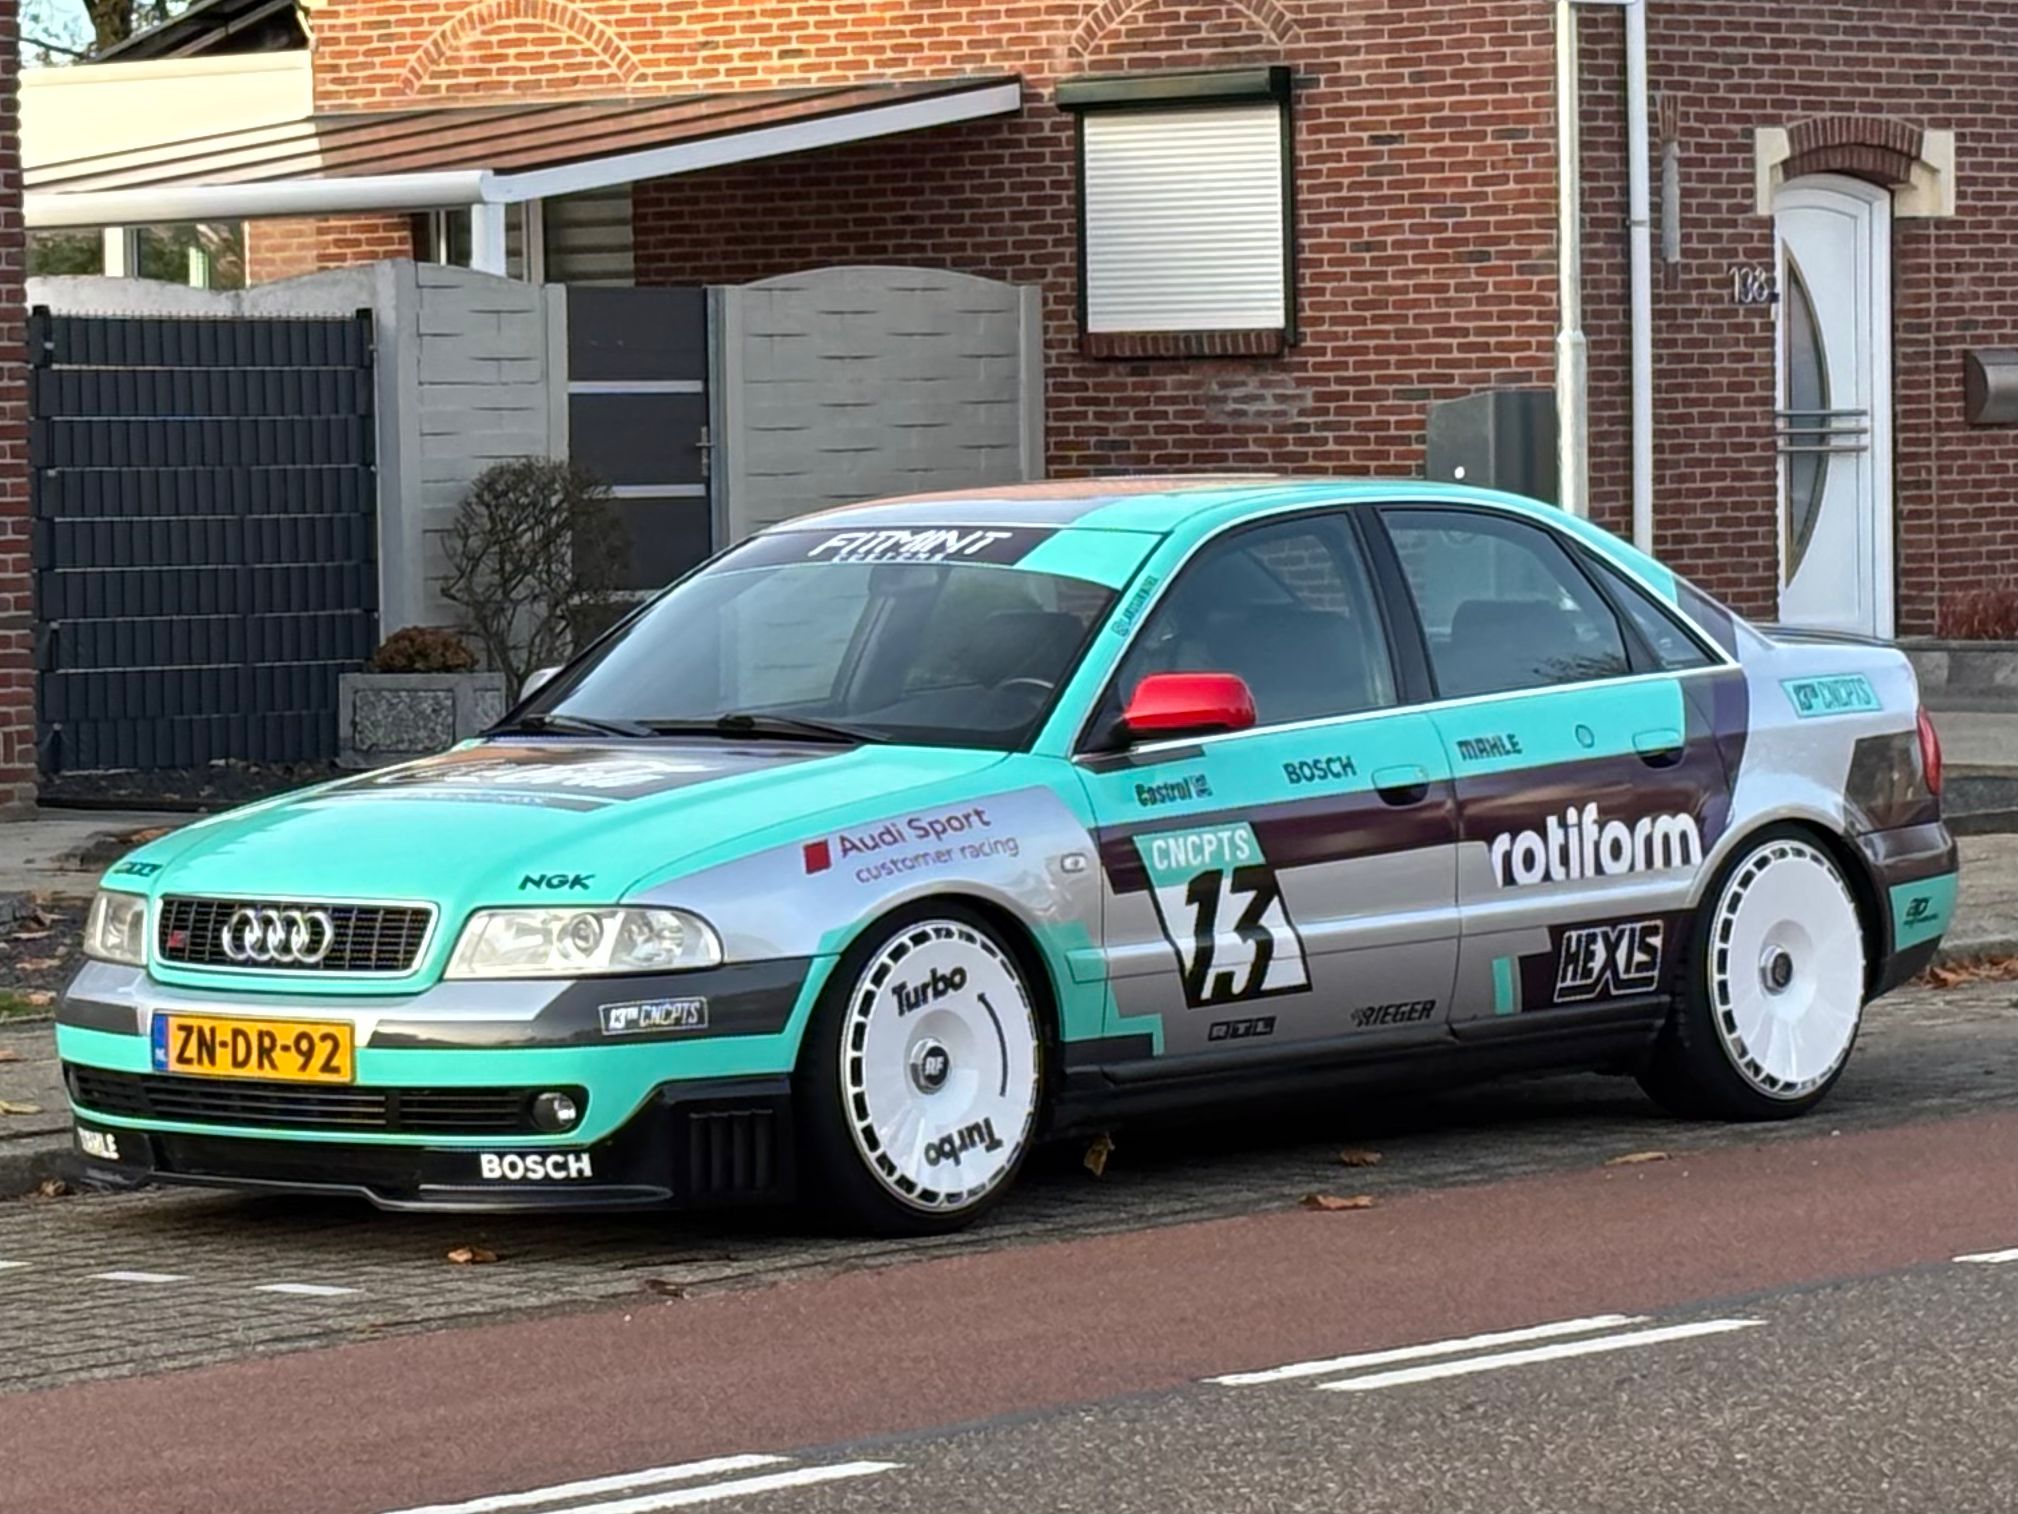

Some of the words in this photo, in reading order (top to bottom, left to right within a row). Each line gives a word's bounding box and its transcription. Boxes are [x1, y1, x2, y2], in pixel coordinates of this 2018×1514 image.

[1727, 266, 1769, 303] 138
[1456, 733, 1522, 761] MAHLE
[1135, 776, 1193, 807] Castrol
[1282, 755, 1358, 785] BOSCH
[838, 822, 907, 858] Audi
[907, 807, 992, 841] Sport
[1151, 827, 1252, 872] CNCPTS
[1491, 802, 1704, 889] rotiform
[518, 873, 596, 891] NGK
[854, 848, 953, 884] customer
[960, 837, 1020, 858] racing
[1185, 864, 1277, 1001] 13
[1553, 919, 1664, 1003] HEXIS
[891, 966, 968, 1017] Turbo
[1352, 1000, 1437, 1028] RIEGER
[639, 1001, 700, 1028] CNCPTS
[175, 1024, 342, 1075] ZN-DR-92
[924, 1117, 1004, 1167] Turbo
[480, 1152, 593, 1180] BOSCH
